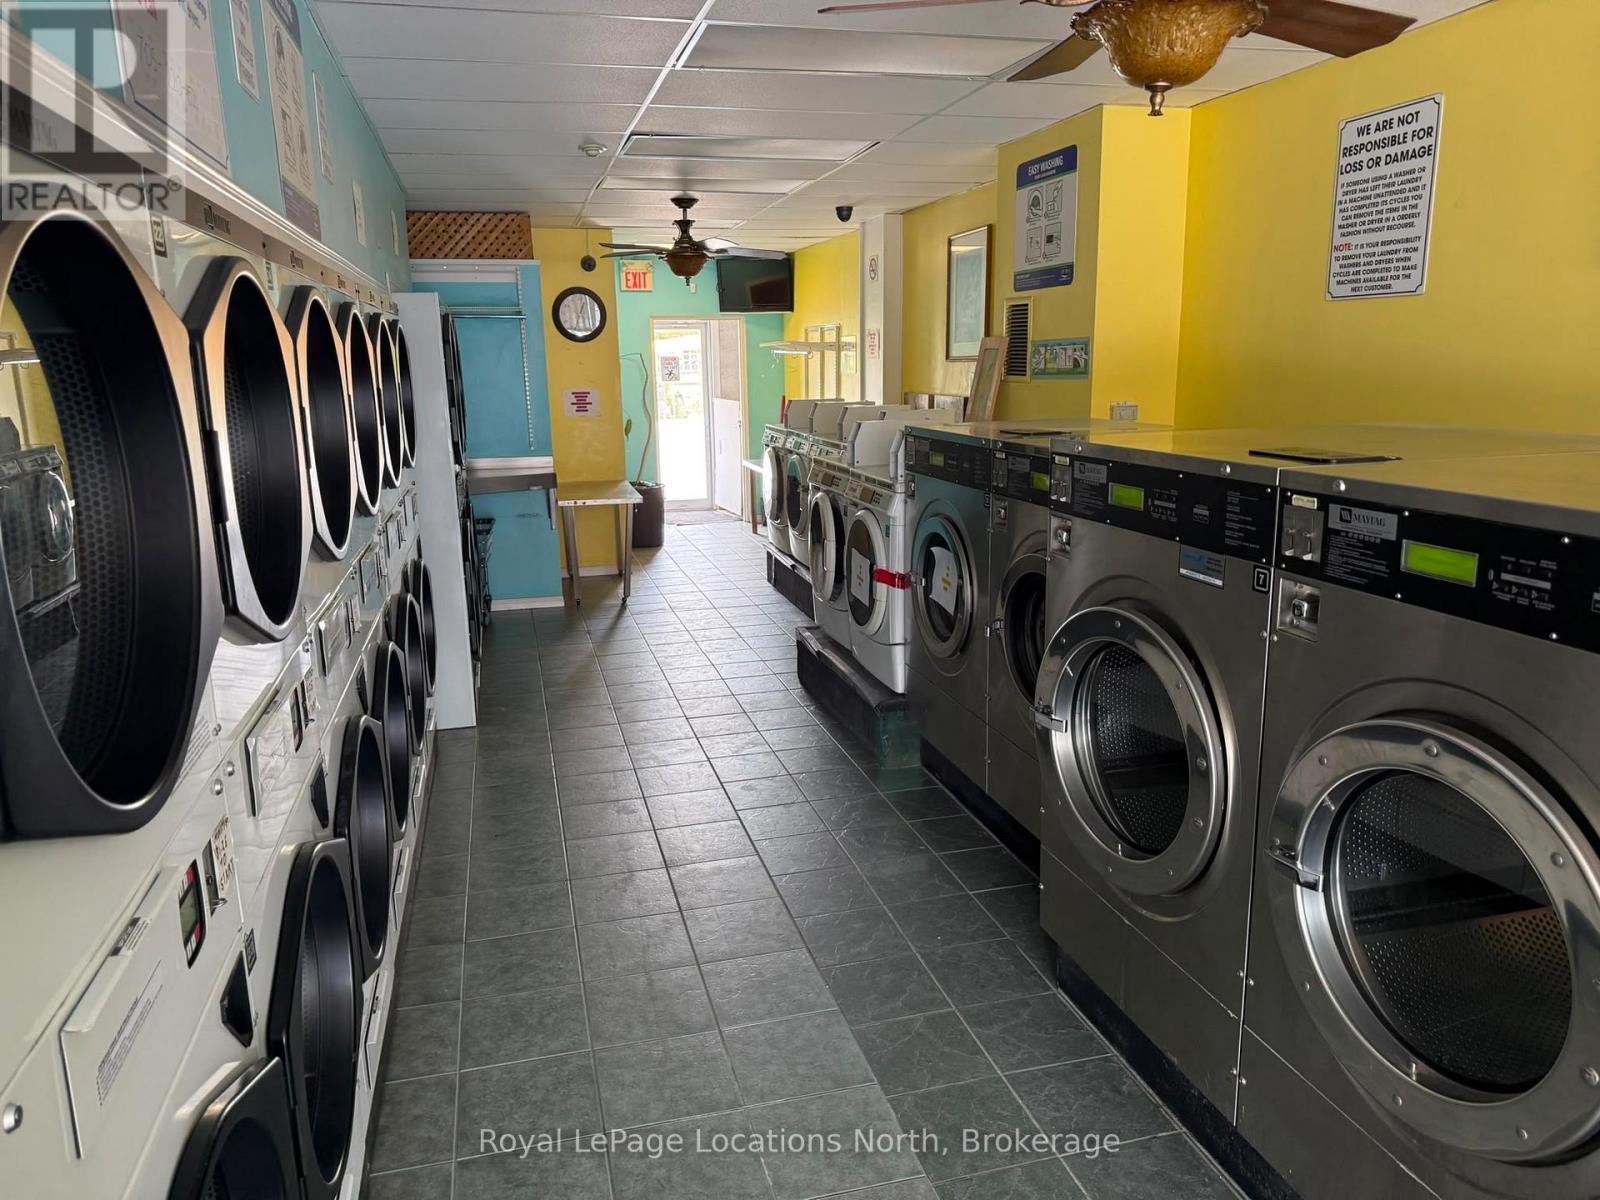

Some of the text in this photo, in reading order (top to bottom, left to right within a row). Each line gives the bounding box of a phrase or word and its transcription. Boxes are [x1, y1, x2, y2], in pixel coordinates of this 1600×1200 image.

[1357, 111, 1420, 137] WE ARE NOT
[1343, 126, 1433, 158] RESPONSIBLE FOR
[1028, 164, 1039, 175] EASY
[1041, 156, 1063, 171] WASHING
[1340, 145, 1433, 175] LOSS OR DAMAGE
[1346, 178, 1369, 187] SOMEONE
[1394, 169, 1416, 178] WASHER
[1342, 189, 1357, 197] DRYER
[1382, 181, 1395, 189] THEIR
[1397, 176, 1422, 186] LAUNDRY
[1349, 195, 1371, 203] MACHINE
[1373, 188, 1406, 199] UNATTENDED
[1350, 201, 1379, 212] COMPLETED
[1353, 210, 1373, 219] REMOVE
[1385, 206, 1400, 214] ITEMS
[1367, 217, 1383, 225] DRYER
[1397, 212, 1420, 220] ORDERLY
[1363, 226, 1385, 234] WITHOUT
[1334, 243, 1353, 252] NOTE:
[1381, 236, 1421, 246] RESPONSIBILITY
[1378, 248, 1401, 256] LAUNDRY
[1362, 267, 1391, 275] COMPLETED
[625, 272, 648, 288] EXIT
[1352, 513, 1385, 527] MAYTAG
[1259, 574, 1264, 585] 7
